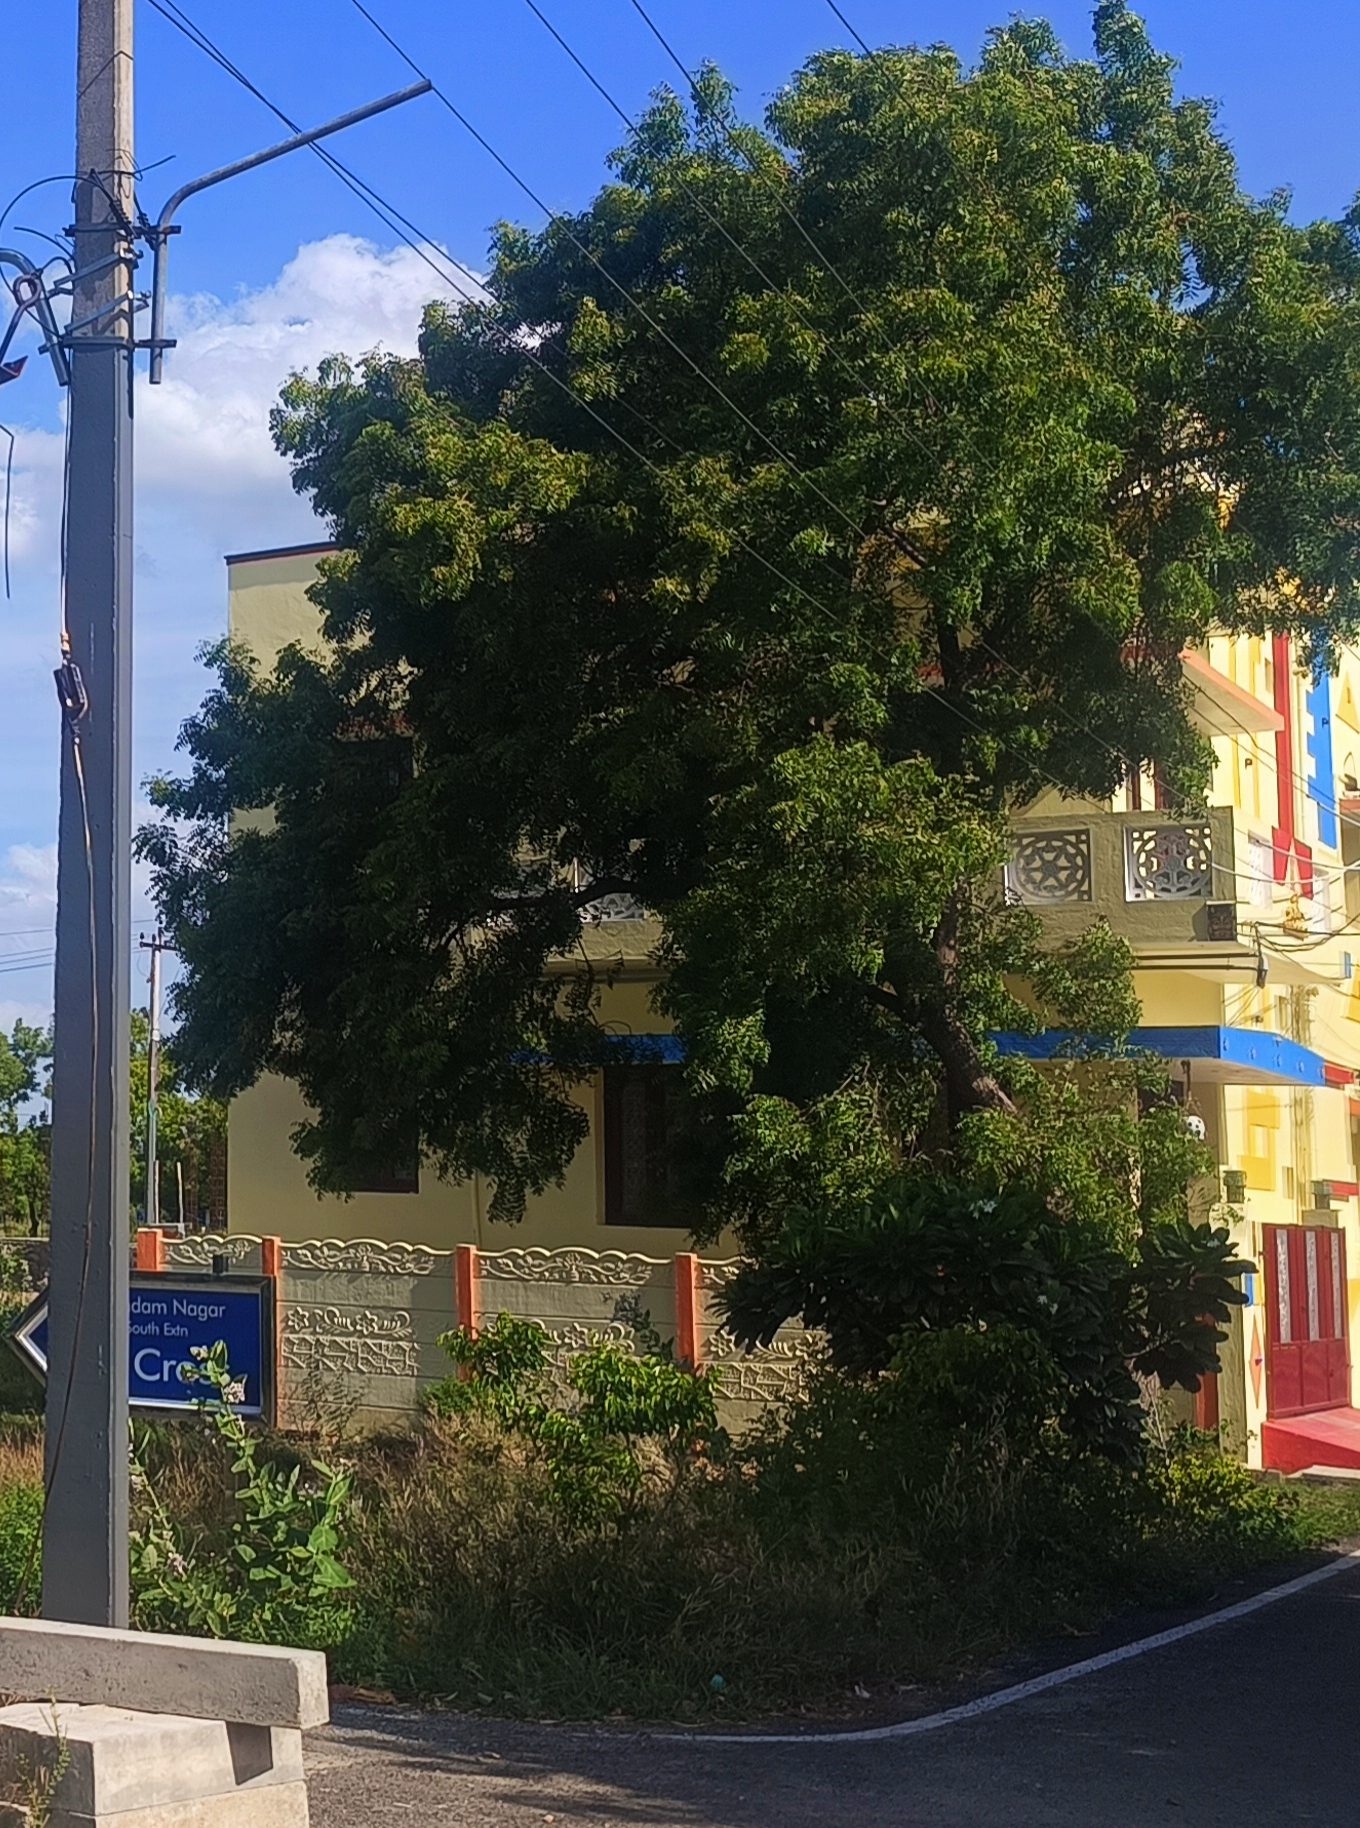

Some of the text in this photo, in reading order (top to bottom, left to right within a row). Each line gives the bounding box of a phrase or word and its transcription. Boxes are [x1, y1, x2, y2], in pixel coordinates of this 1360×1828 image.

[131, 1295, 226, 1321] dam Nagar
[163, 1322, 189, 1337] Extn
[134, 1347, 229, 1387] Cros
